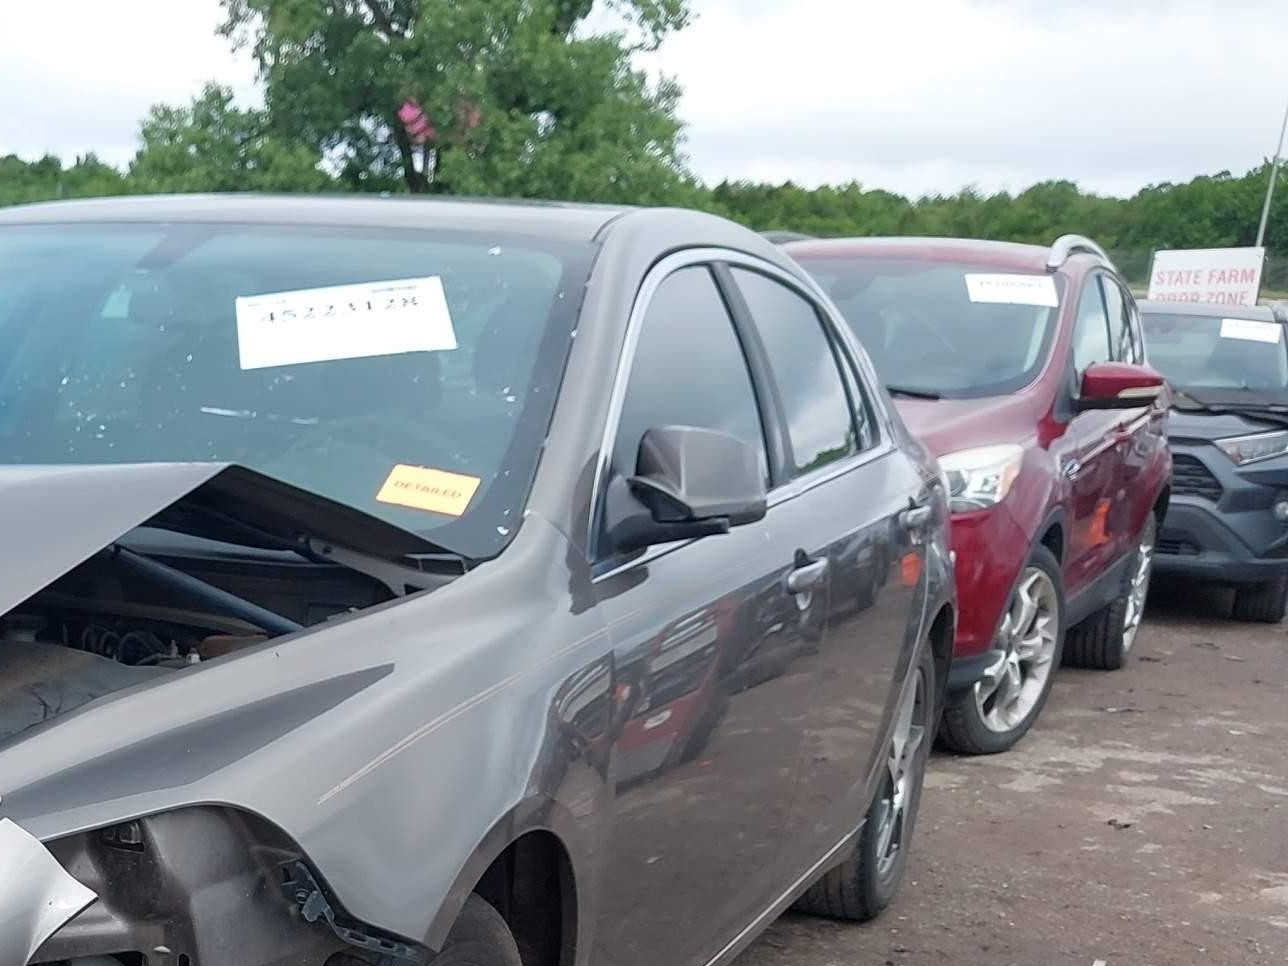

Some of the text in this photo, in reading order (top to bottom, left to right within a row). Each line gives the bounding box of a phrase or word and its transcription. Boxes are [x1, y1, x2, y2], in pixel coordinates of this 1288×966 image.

[1155, 267, 1256, 286] STATE FARM
[1207, 290, 1249, 305] ZONE
[394, 480, 463, 499] DETAILED
